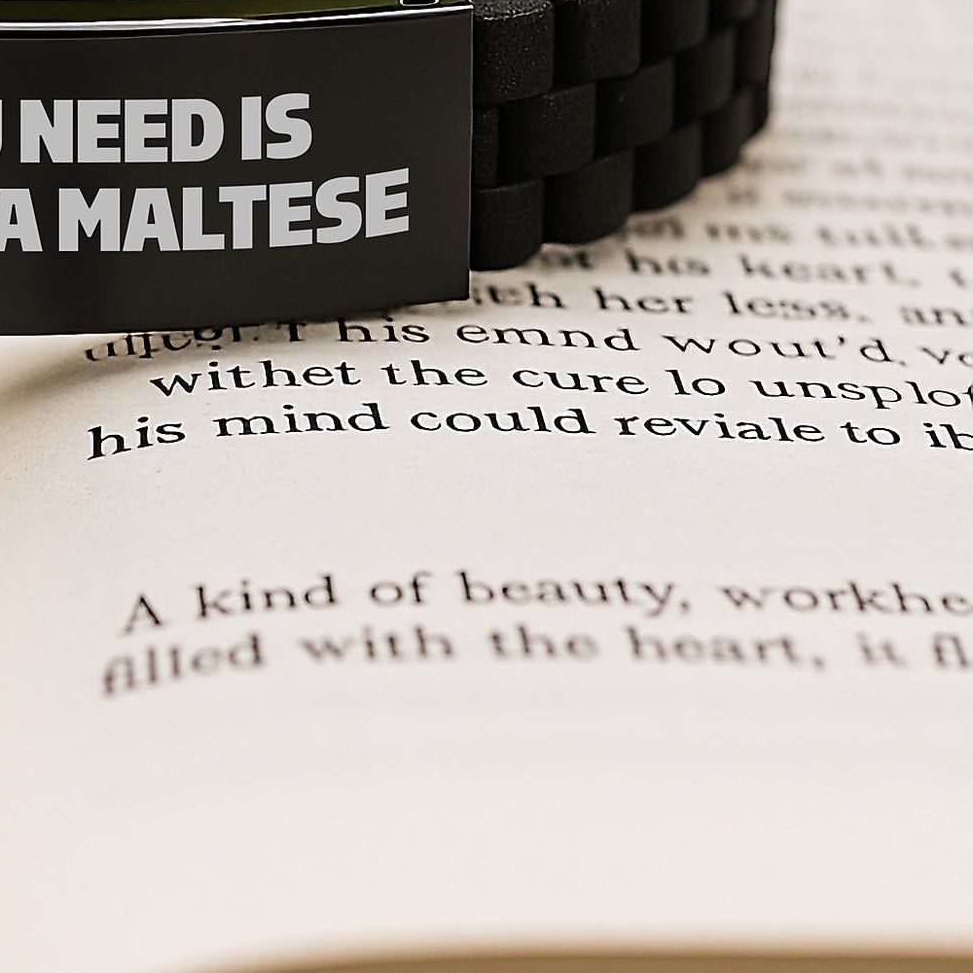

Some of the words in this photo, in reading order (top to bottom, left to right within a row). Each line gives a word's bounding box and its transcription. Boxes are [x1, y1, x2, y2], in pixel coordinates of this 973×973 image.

[20, 98, 225, 164] NEED
[241, 92, 313, 161] IS
[58, 167, 409, 252] MALTESE
[456, 324, 641, 352] emnd
[150, 360, 362, 397] withet
[381, 360, 488, 386] the
[512, 369, 650, 395] cure
[86, 416, 186, 461] his
[212, 403, 391, 437] mind
[410, 405, 597, 435] could
[614, 412, 826, 443] reviale
[840, 420, 901, 446] to
[123, 593, 164, 635] A
[194, 575, 338, 623] kind
[367, 572, 433, 609] of
[457, 569, 692, 619] beauty,
[295, 625, 454, 667] with
[488, 624, 601, 667] the
